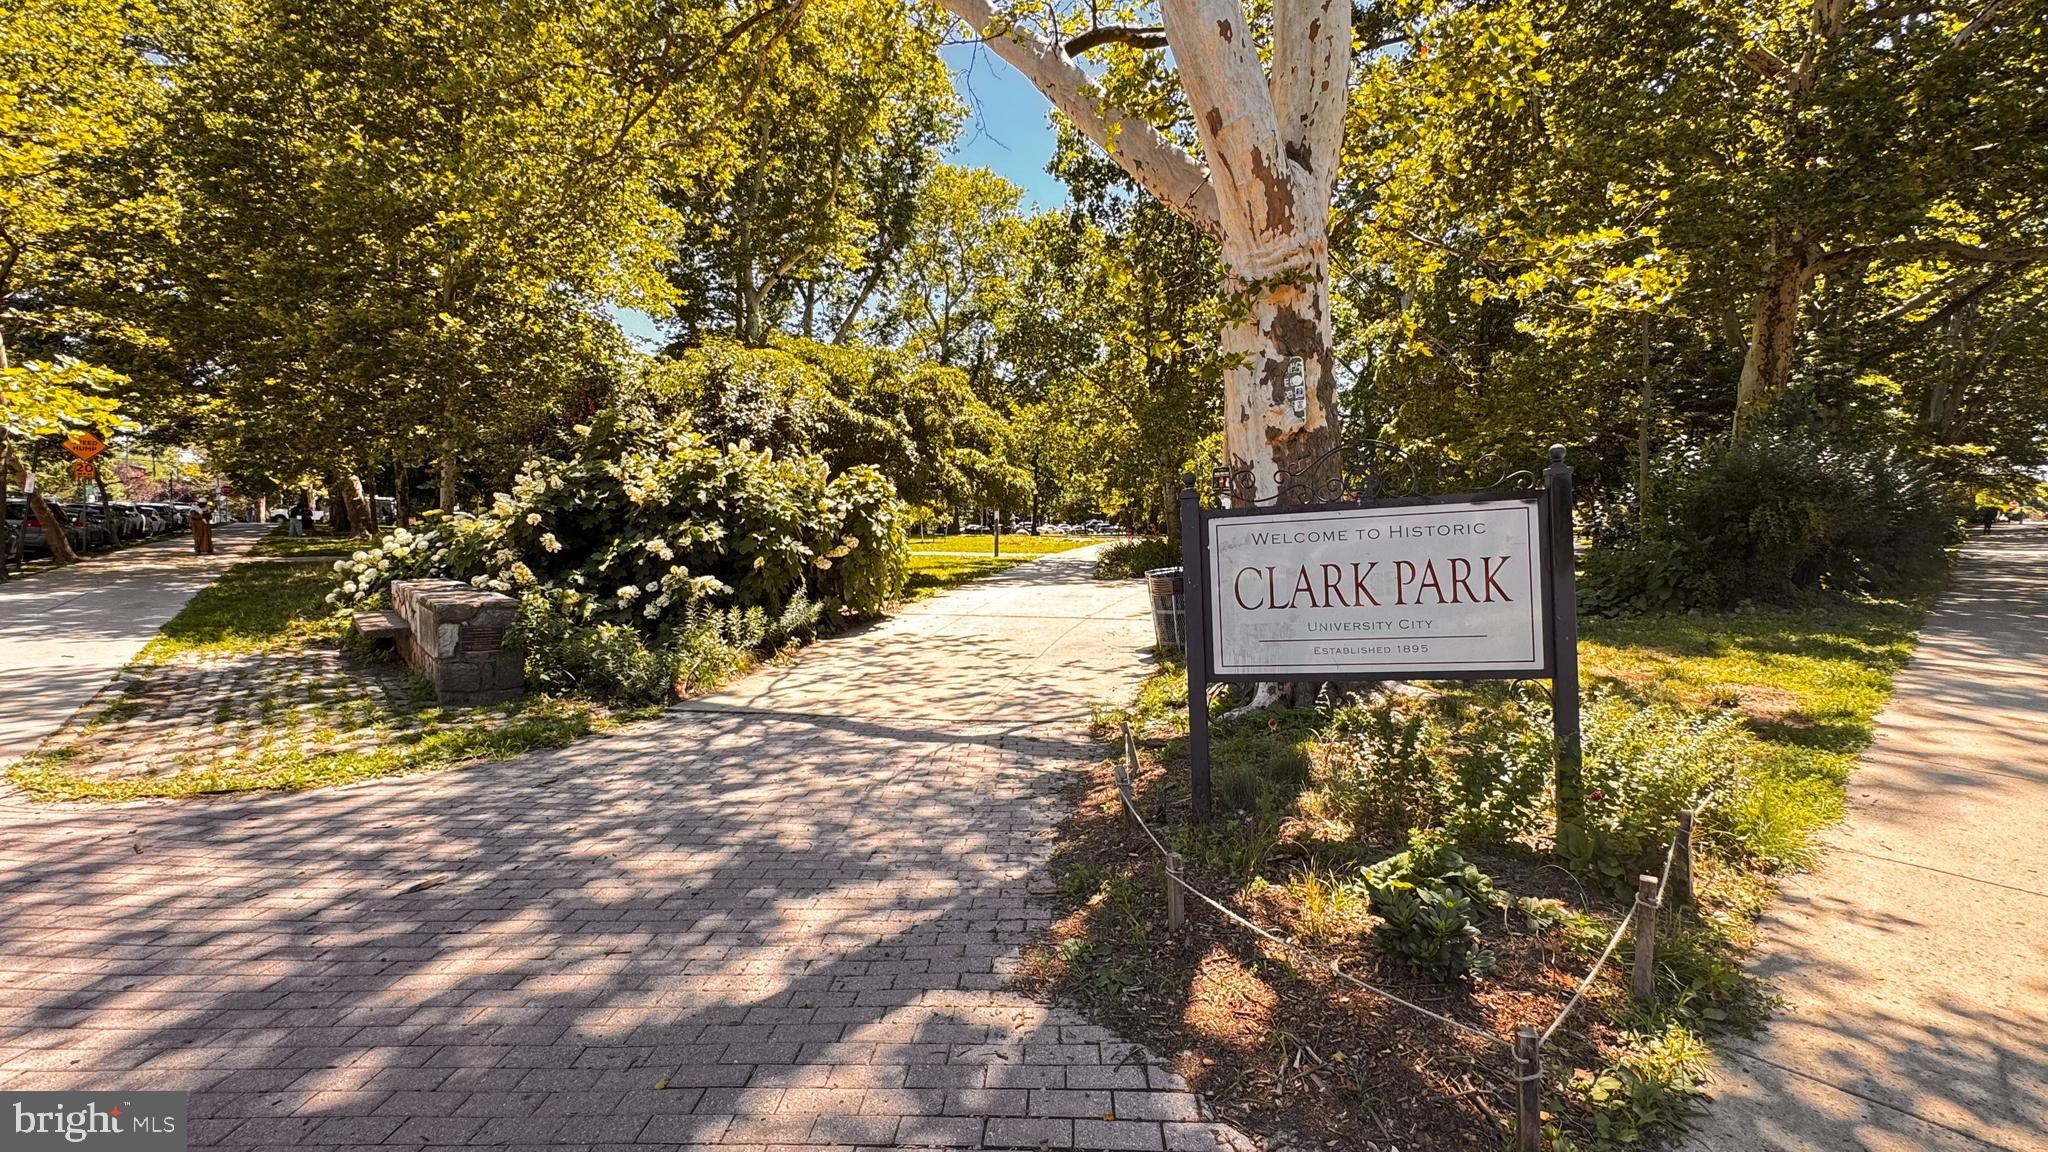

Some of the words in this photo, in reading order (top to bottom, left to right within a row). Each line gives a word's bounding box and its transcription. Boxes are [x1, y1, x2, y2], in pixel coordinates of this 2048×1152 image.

[76, 463, 93, 472] 20
[1251, 529, 1348, 546] WELCOME
[1356, 528, 1380, 541] TO
[1389, 522, 1487, 539] HISTORIC
[1234, 561, 1382, 611] CLARK
[1392, 555, 1514, 605] PARK
[1307, 621, 1394, 632] UNIVERSITY
[1398, 618, 1433, 631] CITY
[1313, 645, 1392, 656] ESTABLISHED
[1397, 644, 1429, 654] 1895
